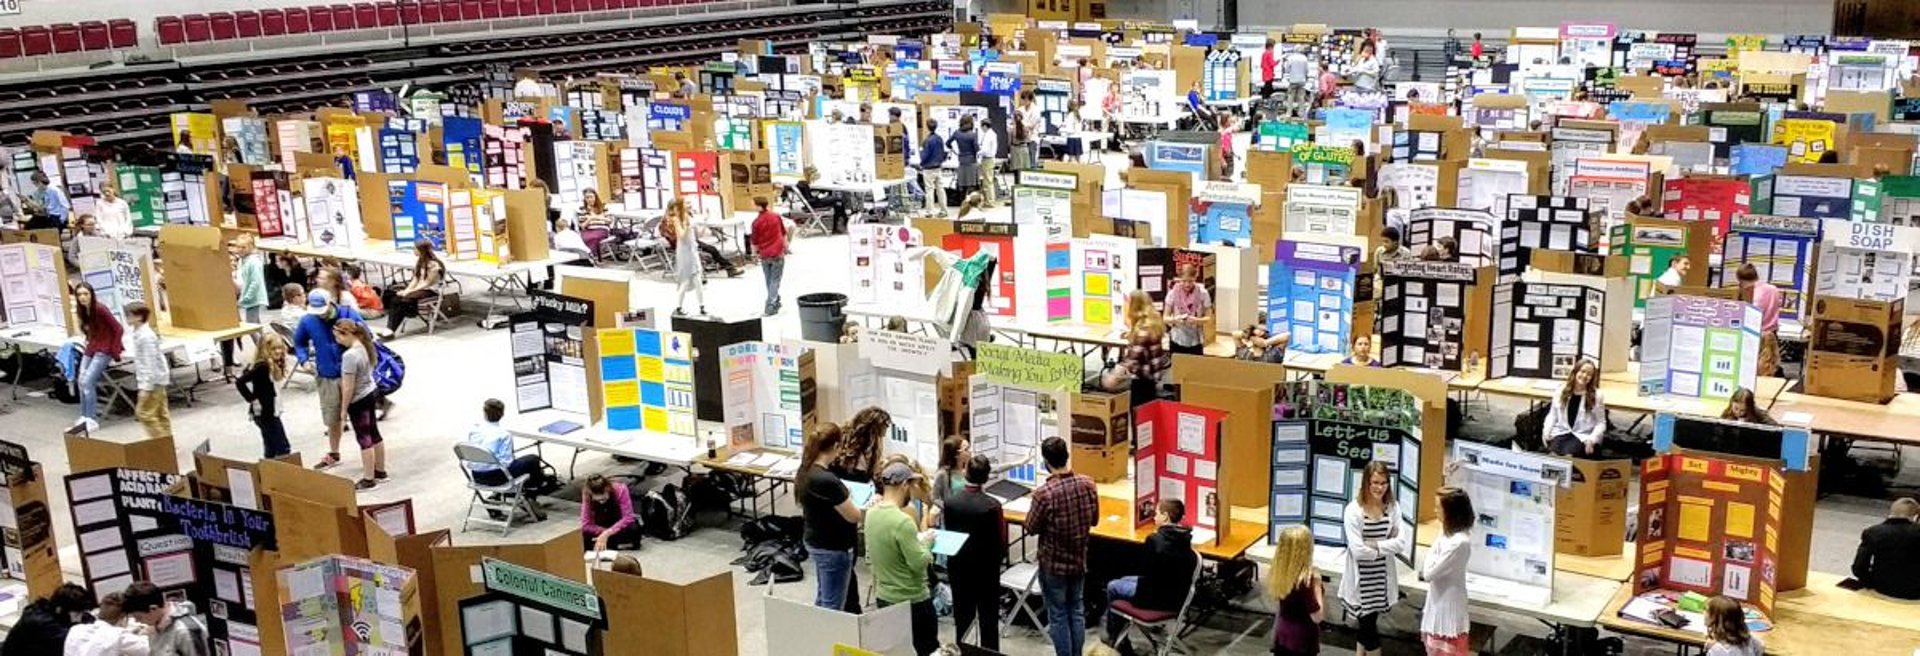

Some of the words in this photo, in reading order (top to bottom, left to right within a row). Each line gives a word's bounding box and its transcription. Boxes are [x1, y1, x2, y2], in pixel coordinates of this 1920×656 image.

[654, 105, 684, 116] CLOUDS
[1852, 223, 1895, 237] DISH
[1849, 235, 1893, 249] SOAP
[979, 343, 1009, 361] Social
[1012, 349, 1051, 367] Media
[977, 360, 1021, 384] Making
[1024, 366, 1044, 383] You
[1314, 420, 1390, 441] Lett-us
[1336, 440, 1371, 460] See
[117, 468, 161, 483] AFFECT
[163, 495, 217, 523] Bacteria
[221, 502, 235, 523] In
[240, 510, 270, 532] Your
[180, 519, 252, 546] Toothbrush
[139, 537, 190, 551] Question
[495, 566, 538, 593] Colorful
[541, 580, 587, 607] Canines
